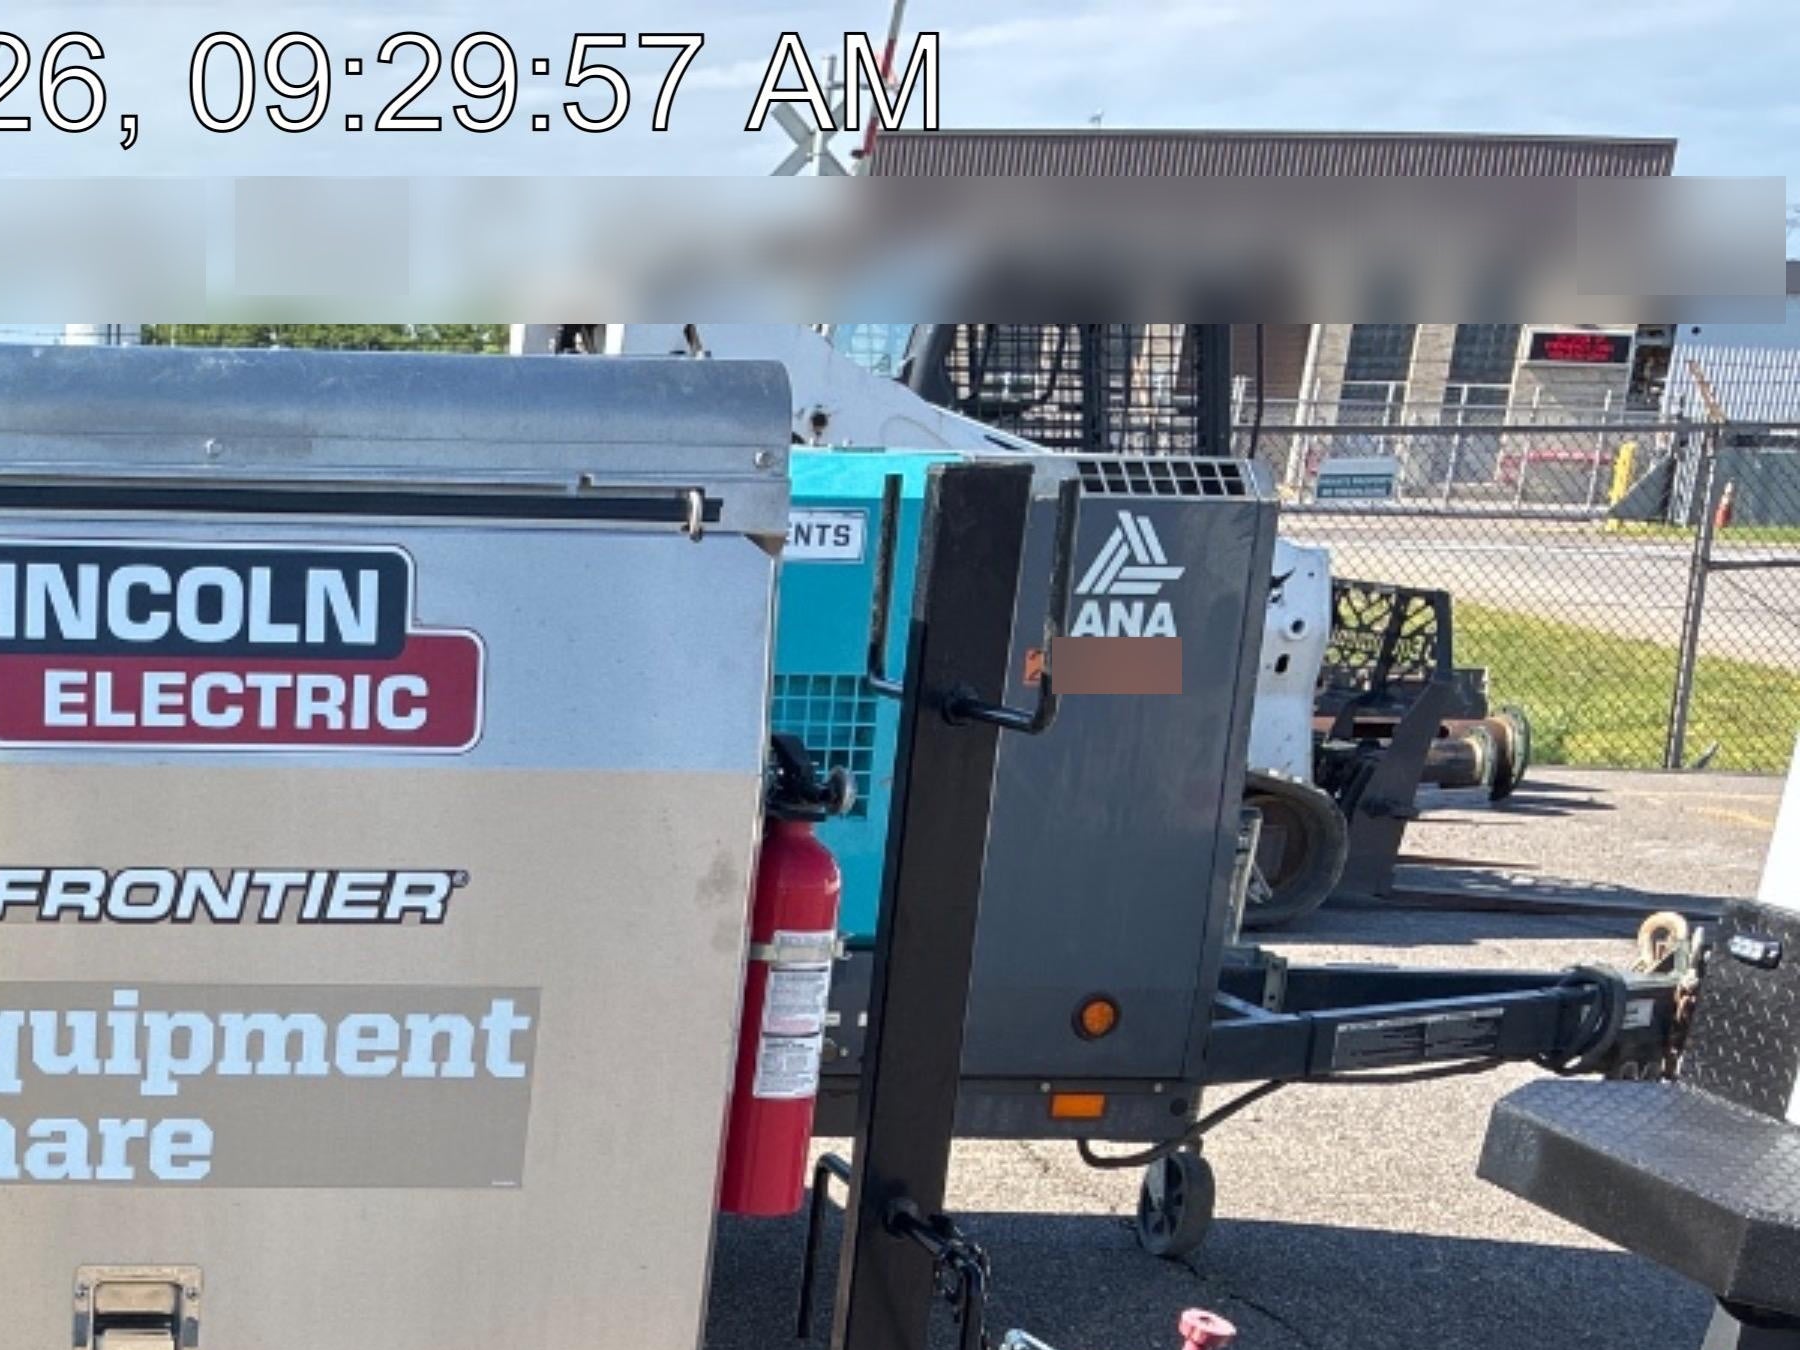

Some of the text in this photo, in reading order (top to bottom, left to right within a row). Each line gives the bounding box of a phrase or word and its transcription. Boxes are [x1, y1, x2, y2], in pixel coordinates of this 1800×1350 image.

[786, 522, 852, 547] NTS
[1069, 600, 1177, 638] ANA
[43, 669, 430, 731] ELECTRIC
